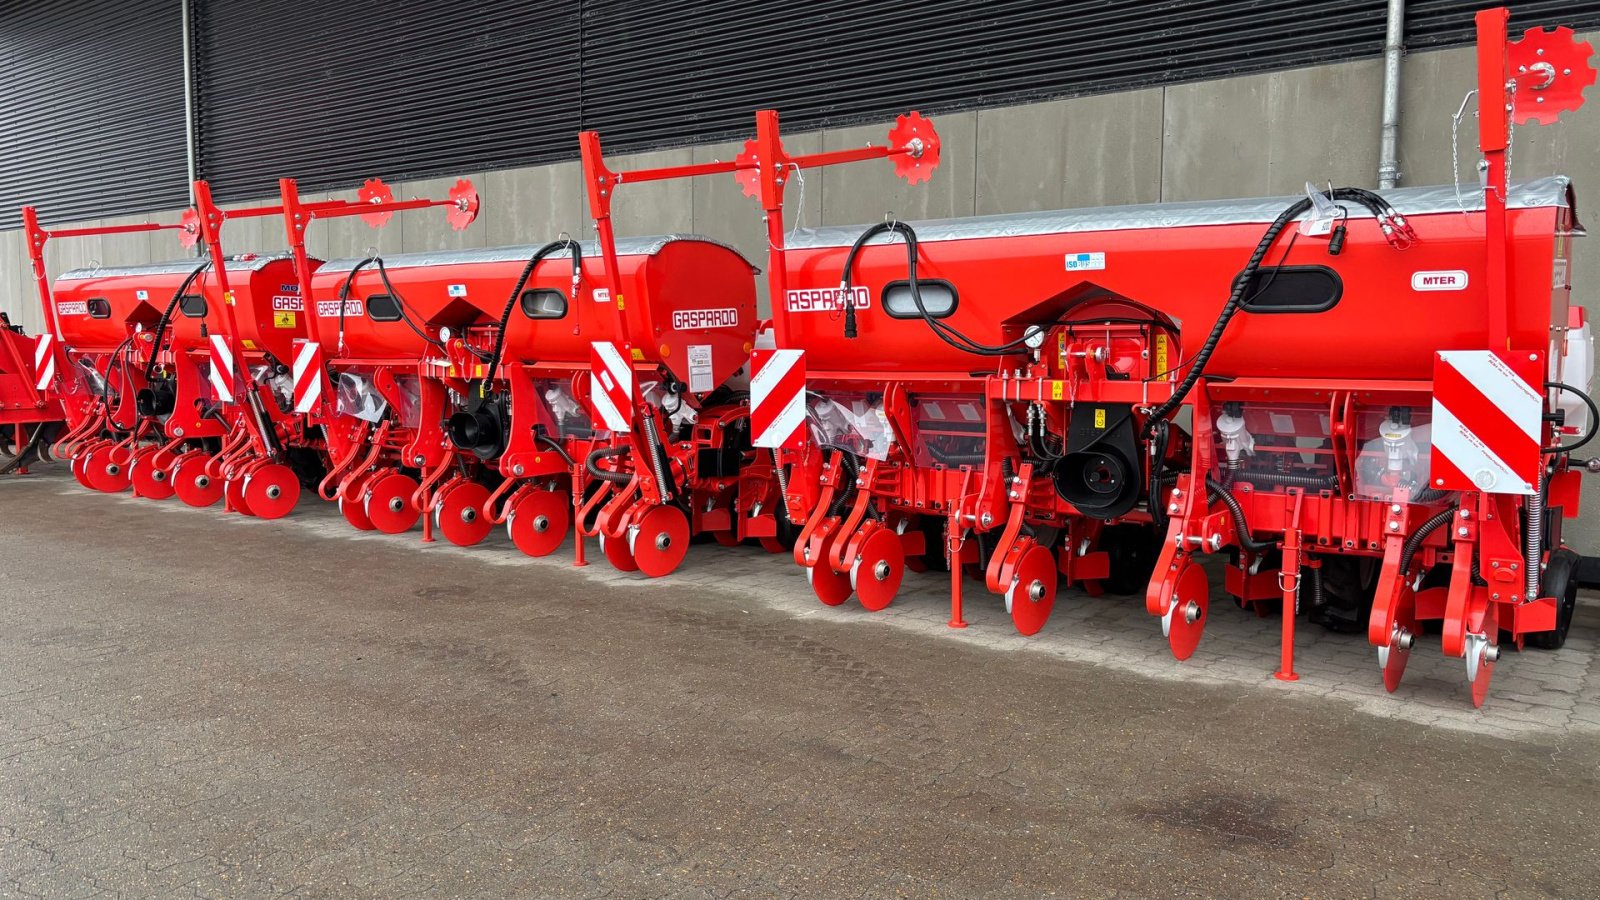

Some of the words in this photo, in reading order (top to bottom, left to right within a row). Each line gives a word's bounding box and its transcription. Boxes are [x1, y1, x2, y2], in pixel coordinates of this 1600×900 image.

[1423, 276, 1456, 285] MTER
[788, 288, 869, 310] ASPADO
[317, 301, 363, 315] GASPRDO
[674, 310, 737, 328] GASPARDO
